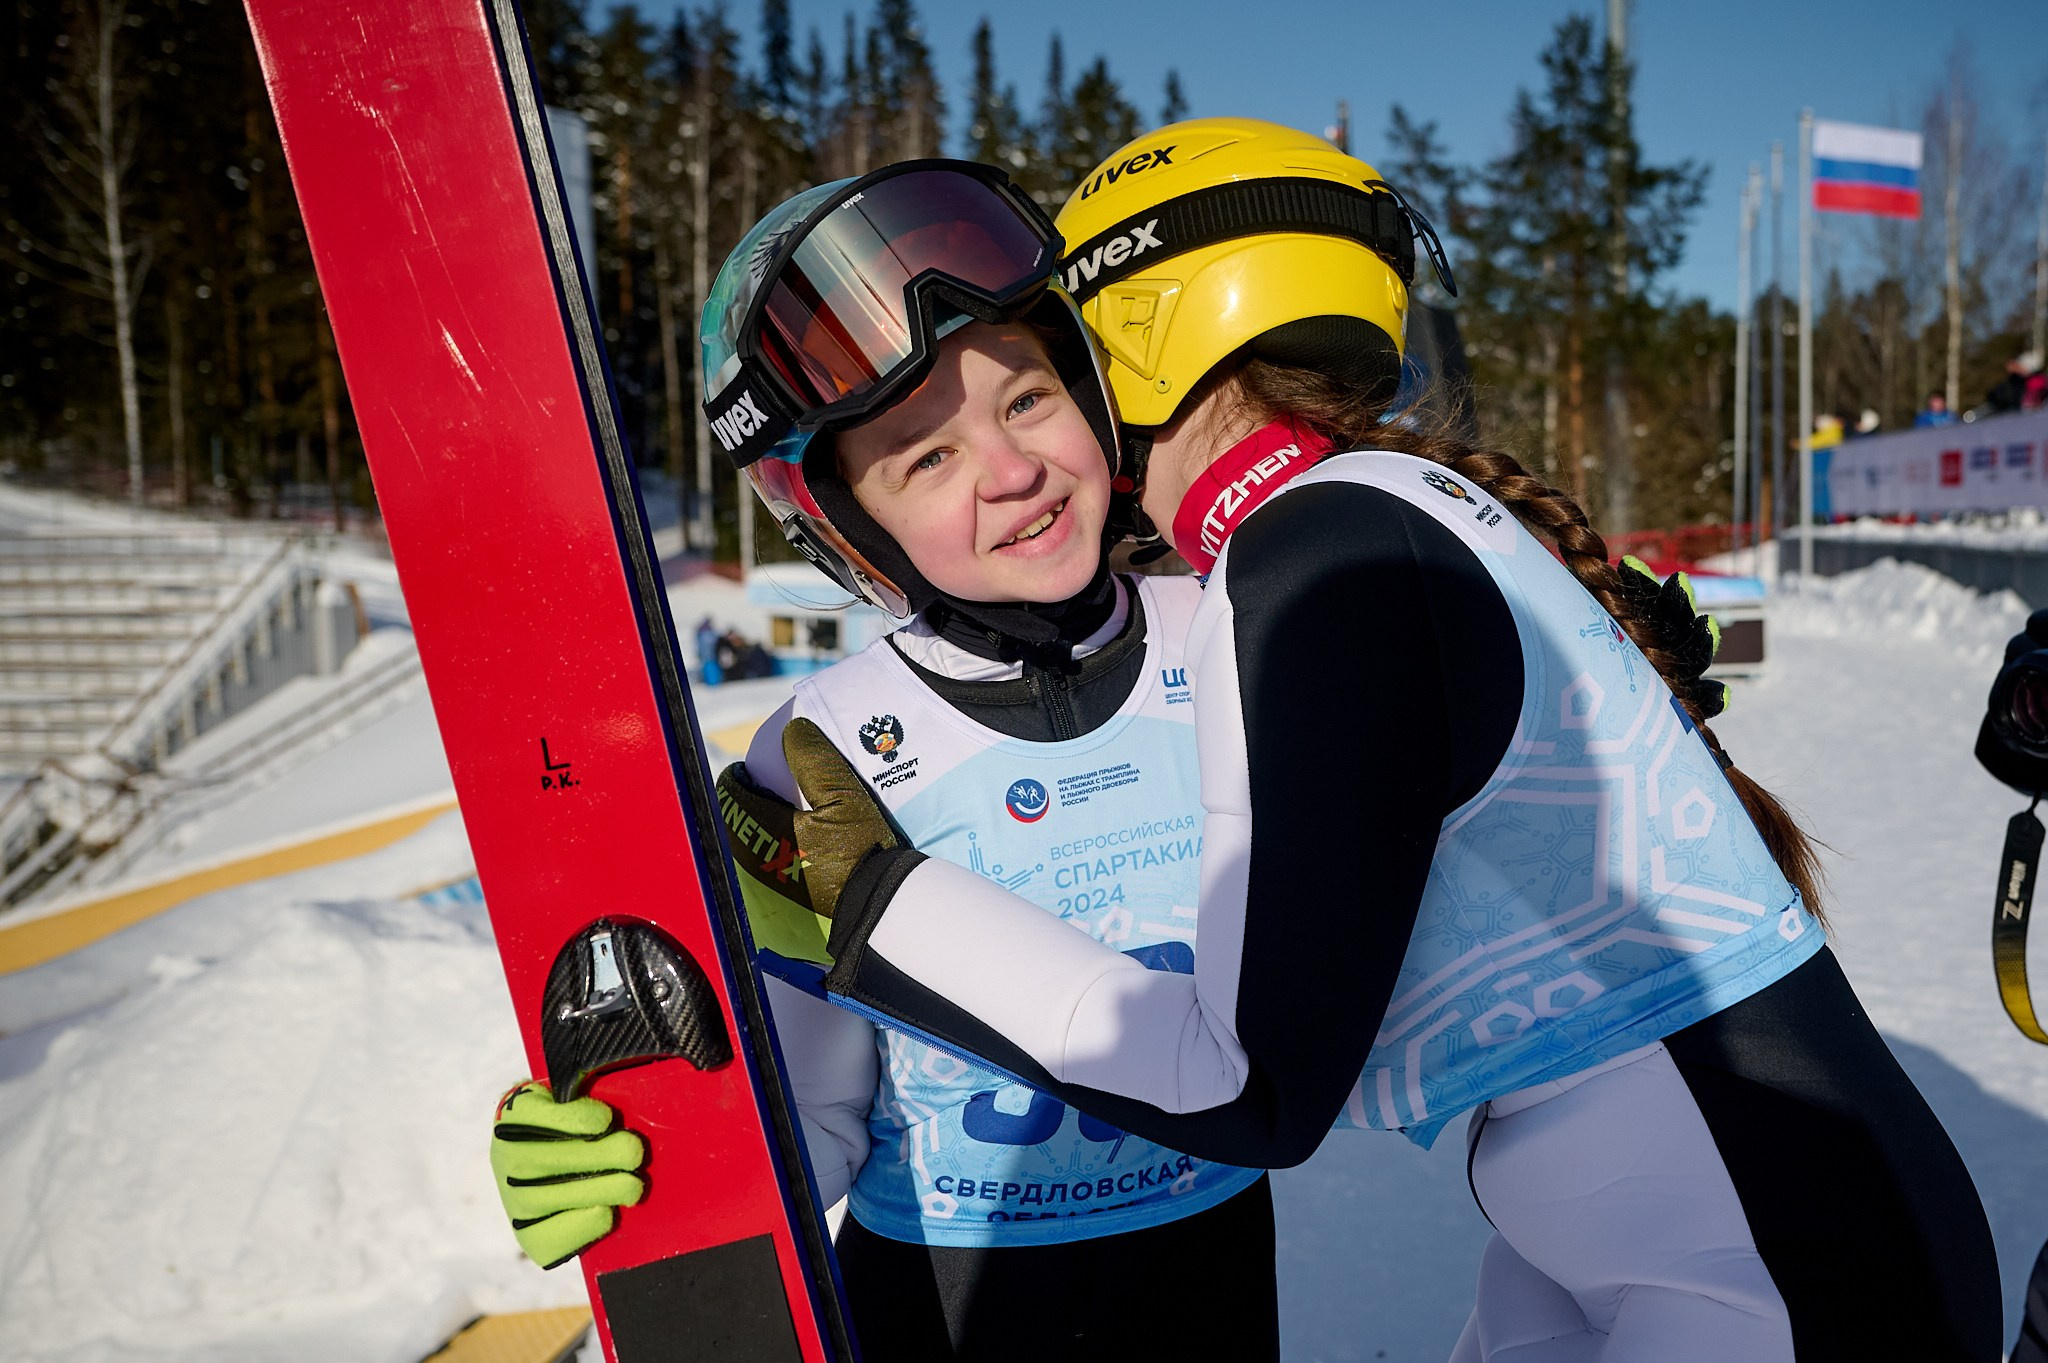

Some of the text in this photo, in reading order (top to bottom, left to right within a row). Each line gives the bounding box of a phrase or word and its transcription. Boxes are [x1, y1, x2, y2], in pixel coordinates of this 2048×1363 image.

[1081, 145, 1178, 201] uvex
[841, 192, 865, 210] uvex
[1059, 218, 1164, 294] uvex
[710, 389, 770, 452] uvex
[540, 737, 571, 771] L
[872, 757, 919, 784] МИНСПОРТ
[880, 769, 918, 790] РОССИИ
[1057, 763, 1131, 785] ФЕДЕРАЦИЯ ПРЫЖКОВ
[1059, 785, 1069, 793] НА
[1070, 780, 1095, 790] ЛЫЖАХ
[1101, 768, 1140, 782] ТРАМПЛИНА
[1067, 786, 1101, 799] ЛЫЖНОГО
[1101, 776, 1139, 791] ДВОЕБОРЬЯ
[1061, 796, 1090, 807] РОССИИ
[1050, 815, 1195, 861] ВСЕРОССИЙСКАЯ
[1058, 883, 1126, 919] 2024
[2002, 900, 2024, 920] Z
[934, 1154, 1194, 1205] СВЕРДЛОВСКАЯ
